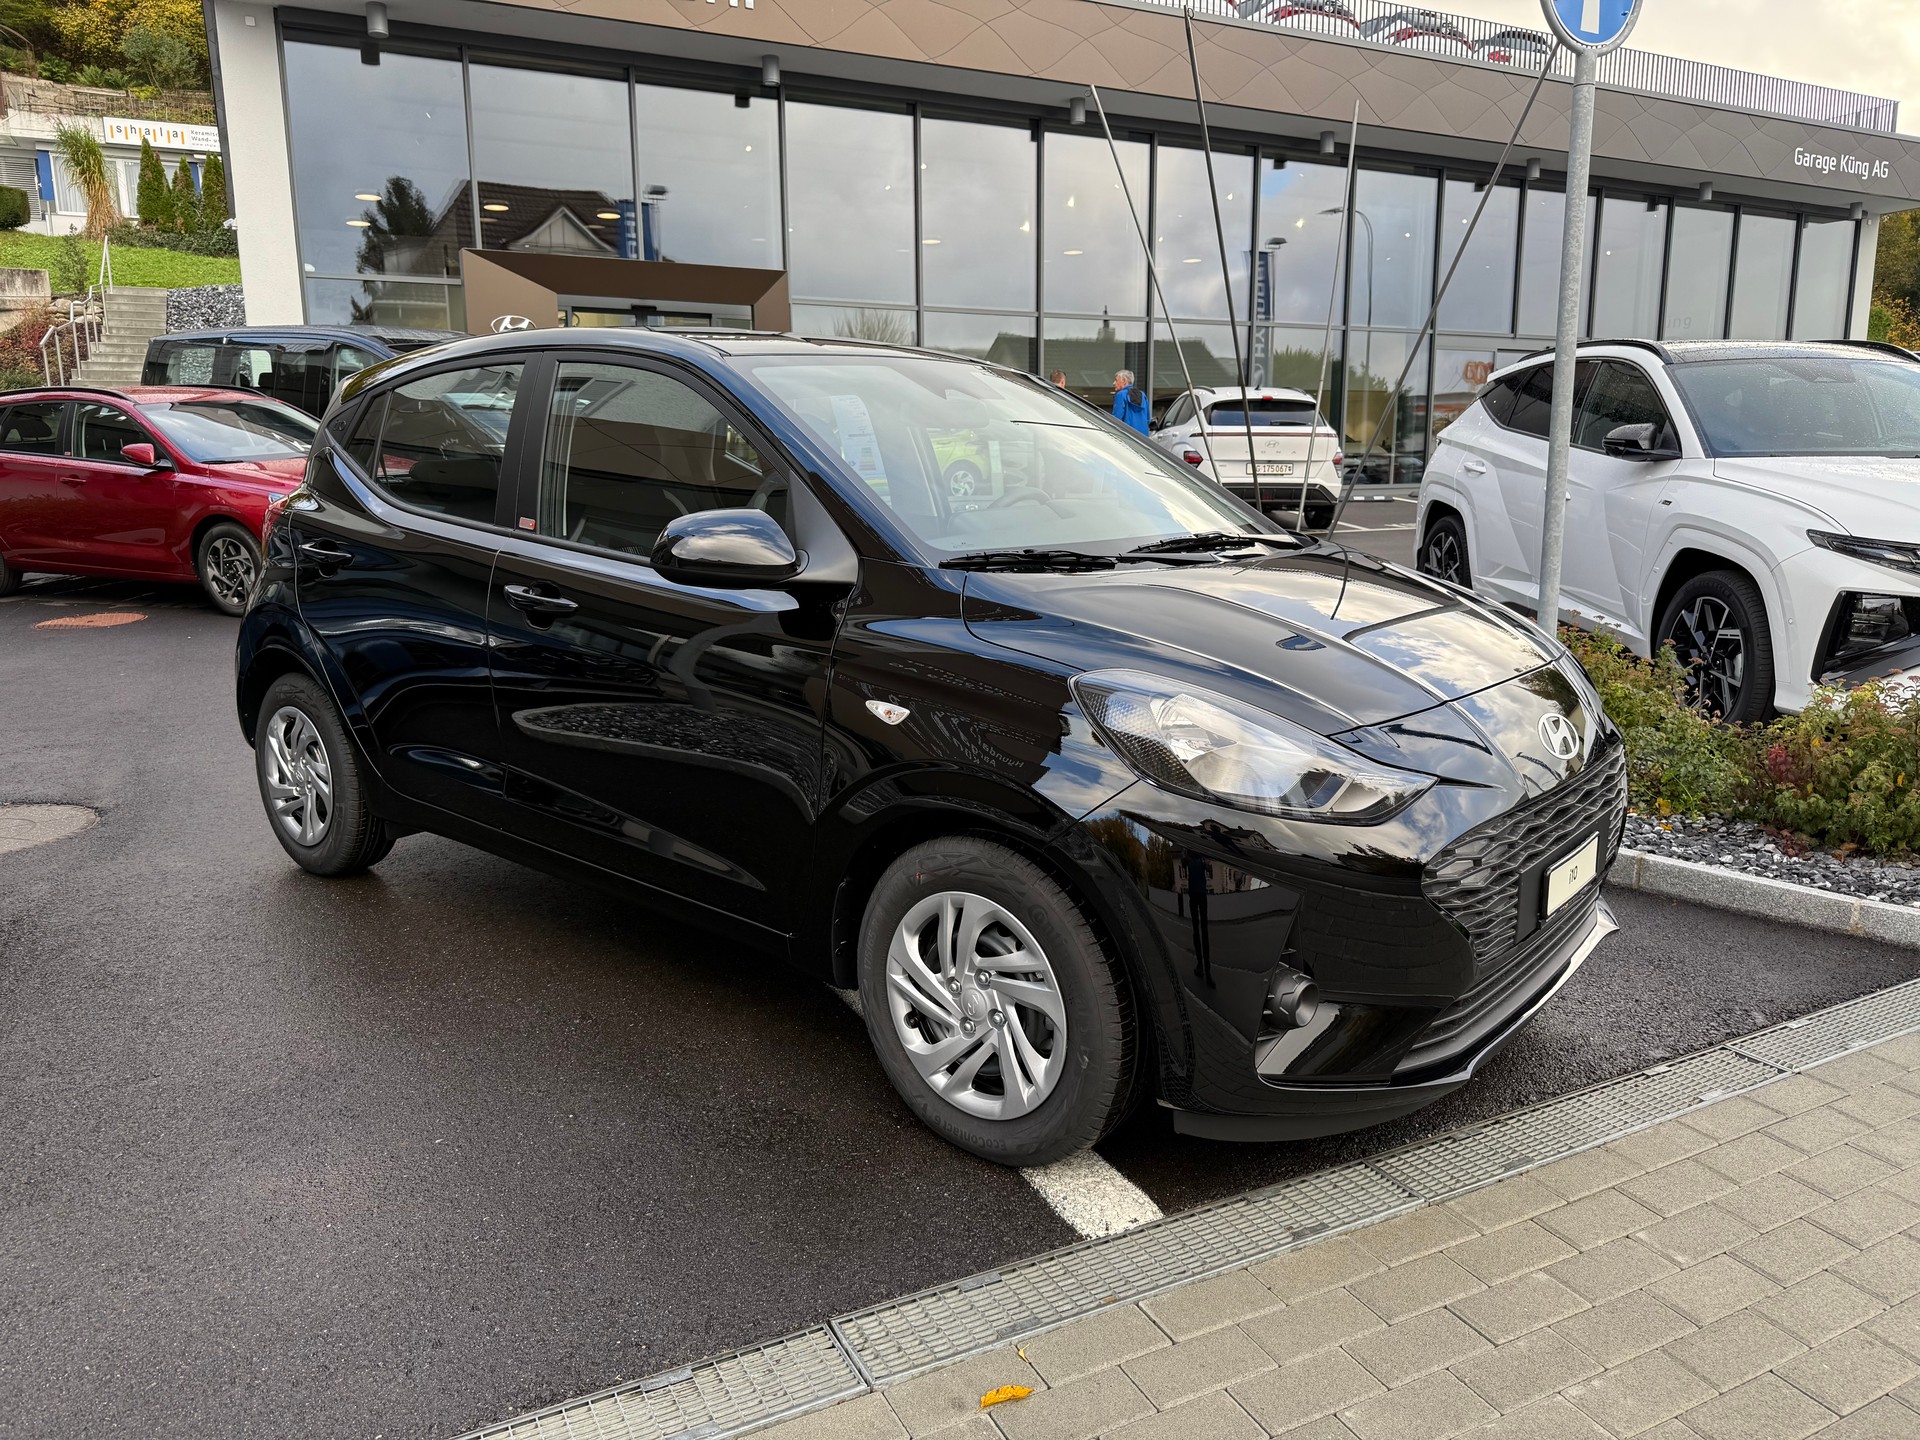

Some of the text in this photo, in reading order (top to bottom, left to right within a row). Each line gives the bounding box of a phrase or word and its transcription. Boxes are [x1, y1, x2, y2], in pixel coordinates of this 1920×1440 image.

[115, 124, 179, 138] shala
[1794, 147, 1889, 180] Garage Küng AG
[1568, 865, 1578, 884] i10
